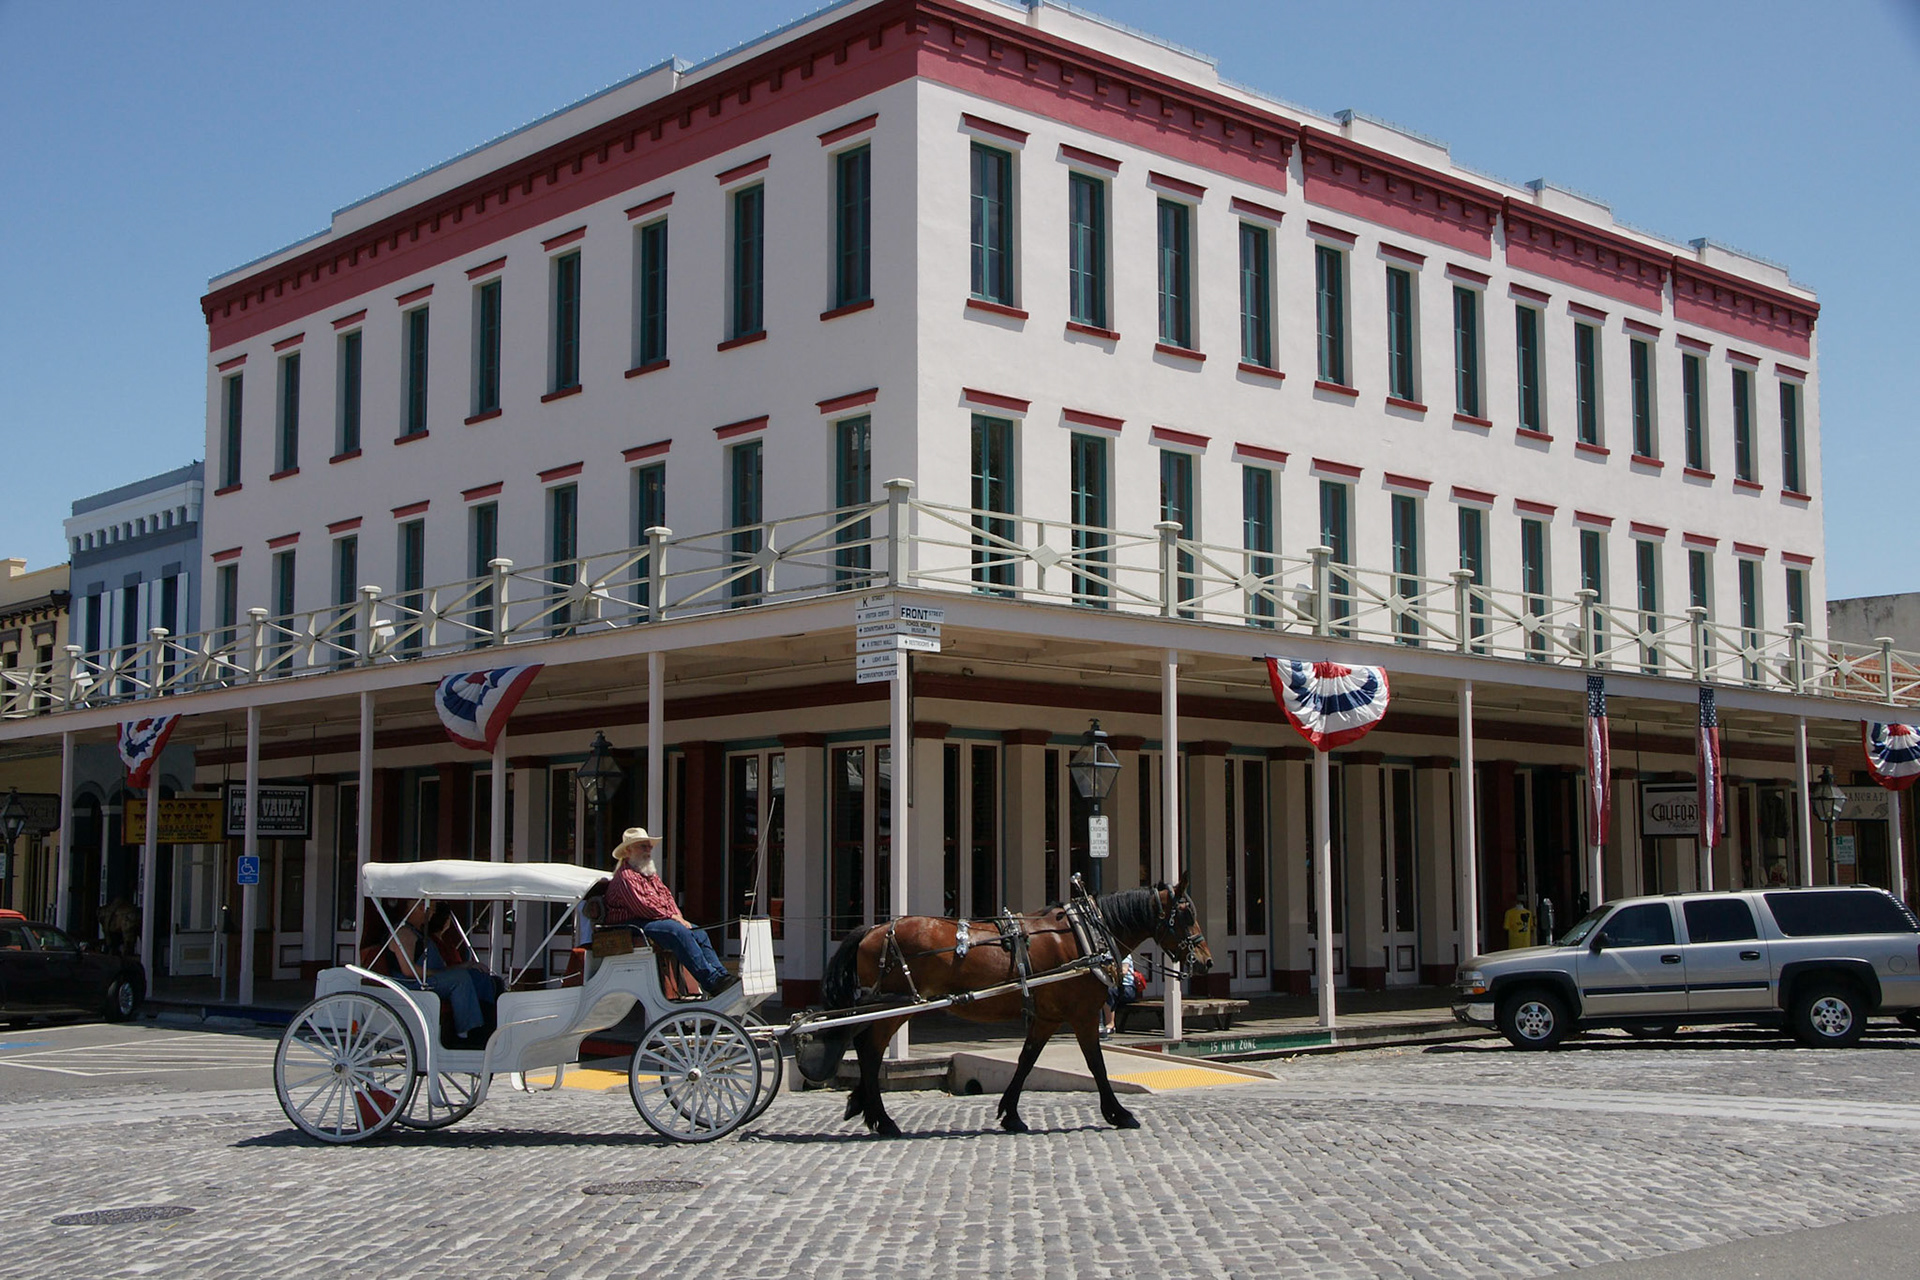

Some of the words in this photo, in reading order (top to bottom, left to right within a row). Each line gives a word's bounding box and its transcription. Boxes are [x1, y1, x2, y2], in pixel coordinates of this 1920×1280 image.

[863, 597, 868, 607] K
[901, 607, 928, 620] FRONT
[261, 798, 302, 817] VAULT
[1651, 803, 1698, 822] CALIFOR
[1210, 1042, 1218, 1052] 15
[1221, 1041, 1235, 1051] MIN
[1239, 1039, 1257, 1050] ZONE
